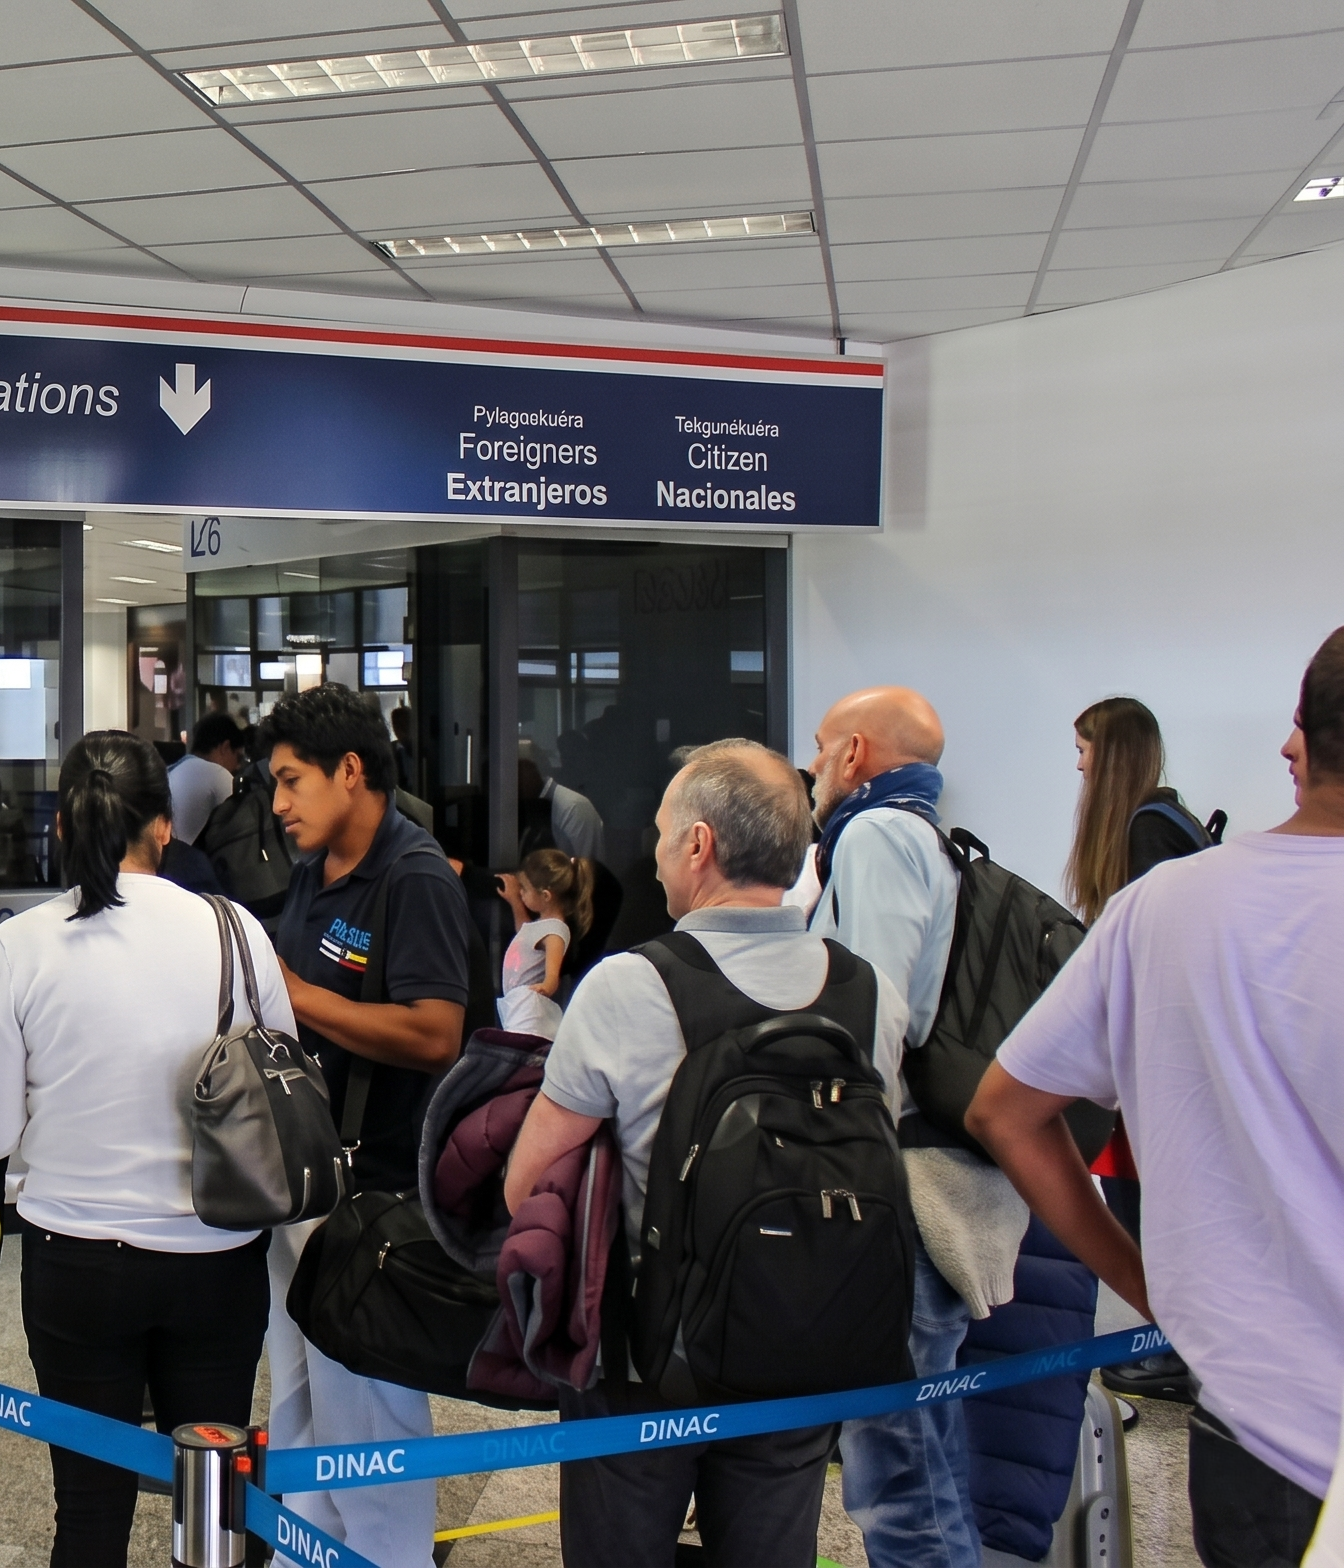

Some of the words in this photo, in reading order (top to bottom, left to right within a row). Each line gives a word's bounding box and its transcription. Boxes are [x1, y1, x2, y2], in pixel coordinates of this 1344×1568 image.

[459, 432, 598, 470] Foreigners
[688, 442, 768, 472] Citizen
[447, 472, 608, 511] Extranjeros
[657, 480, 796, 512] Nacionales
[207, 516, 221, 556] 6
[316, 1448, 406, 1482] DINAC
[639, 1413, 720, 1443] DINAC
[916, 1371, 987, 1402] DINAC
[1130, 1329, 1170, 1353] DIN
